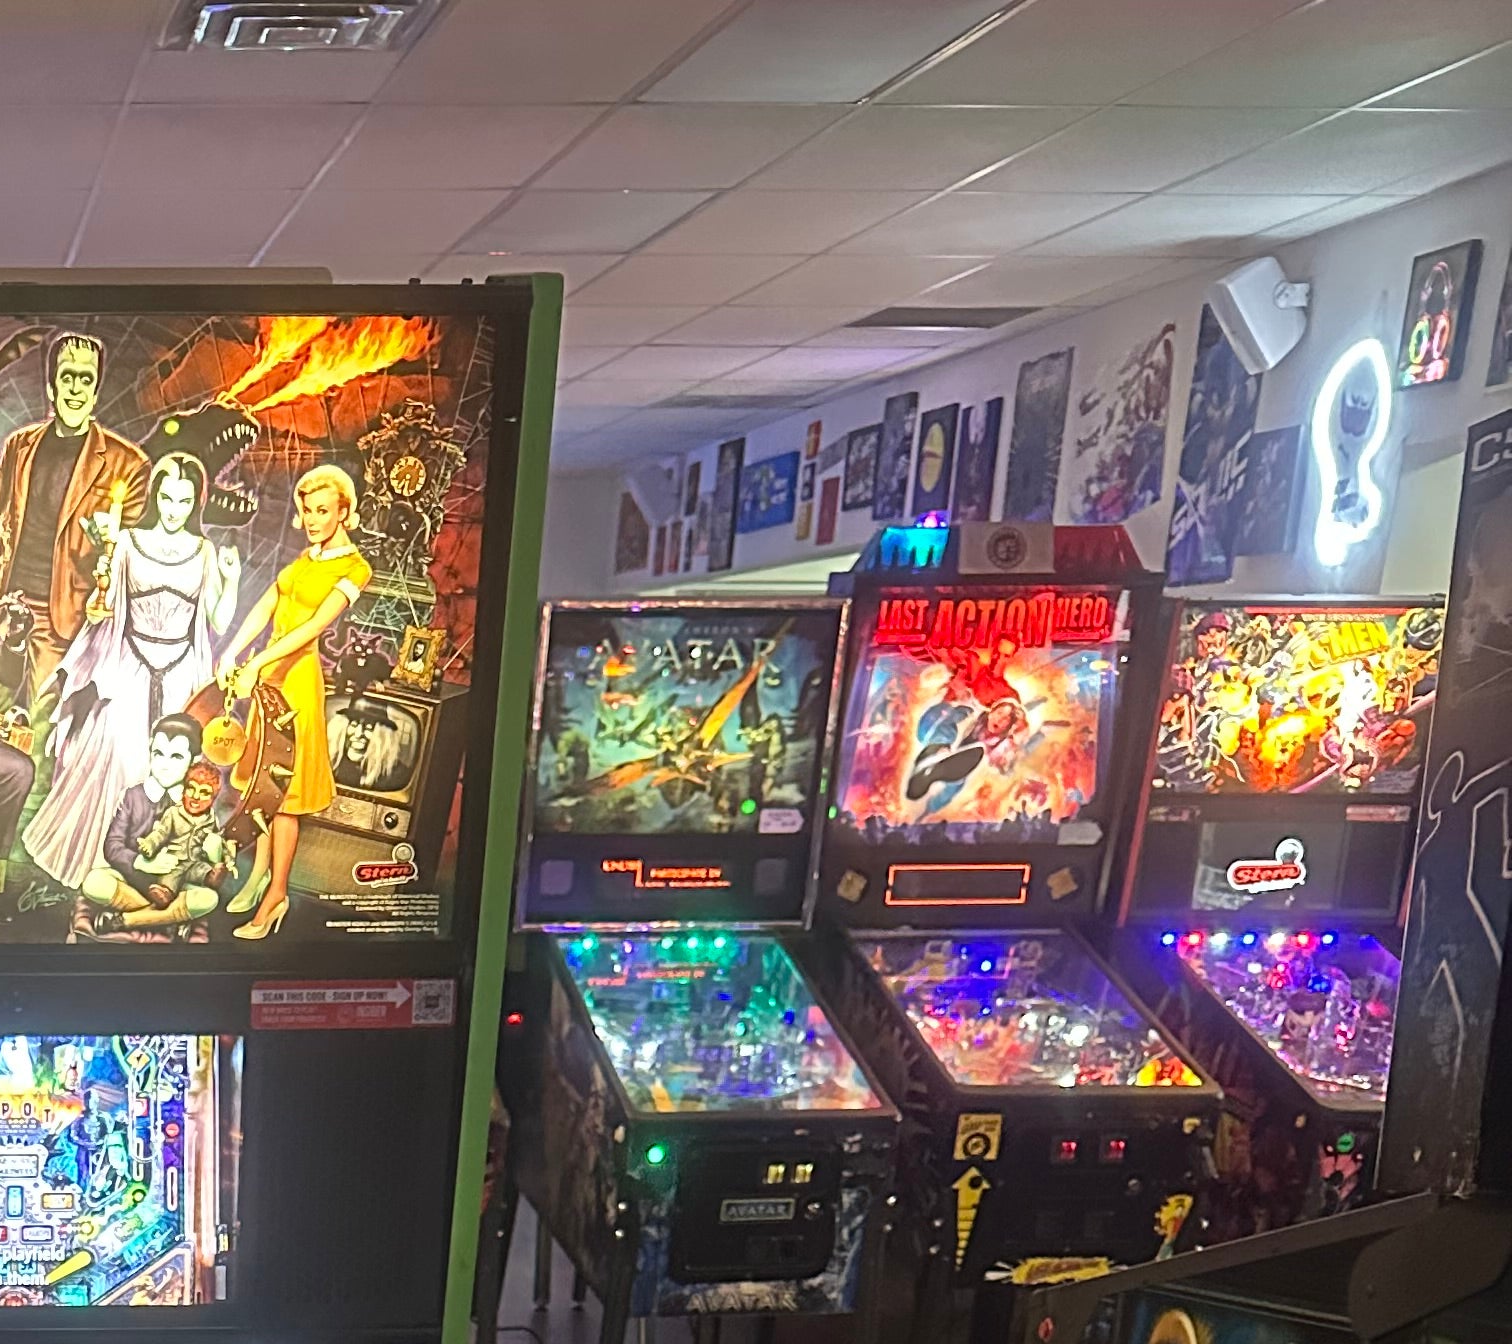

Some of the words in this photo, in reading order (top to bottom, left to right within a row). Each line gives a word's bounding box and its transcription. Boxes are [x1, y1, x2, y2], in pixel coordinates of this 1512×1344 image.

[877, 599, 930, 631] LAST
[929, 593, 1055, 650] ACTION
[1054, 597, 1109, 630] HERO
[588, 639, 780, 673] AVATAR
[213, 736, 235, 747] SPOT
[358, 865, 411, 880] Stern
[1235, 865, 1300, 883] Stern
[728, 1204, 787, 1217] AVATAR
[2, 1246, 66, 1266] playfield
